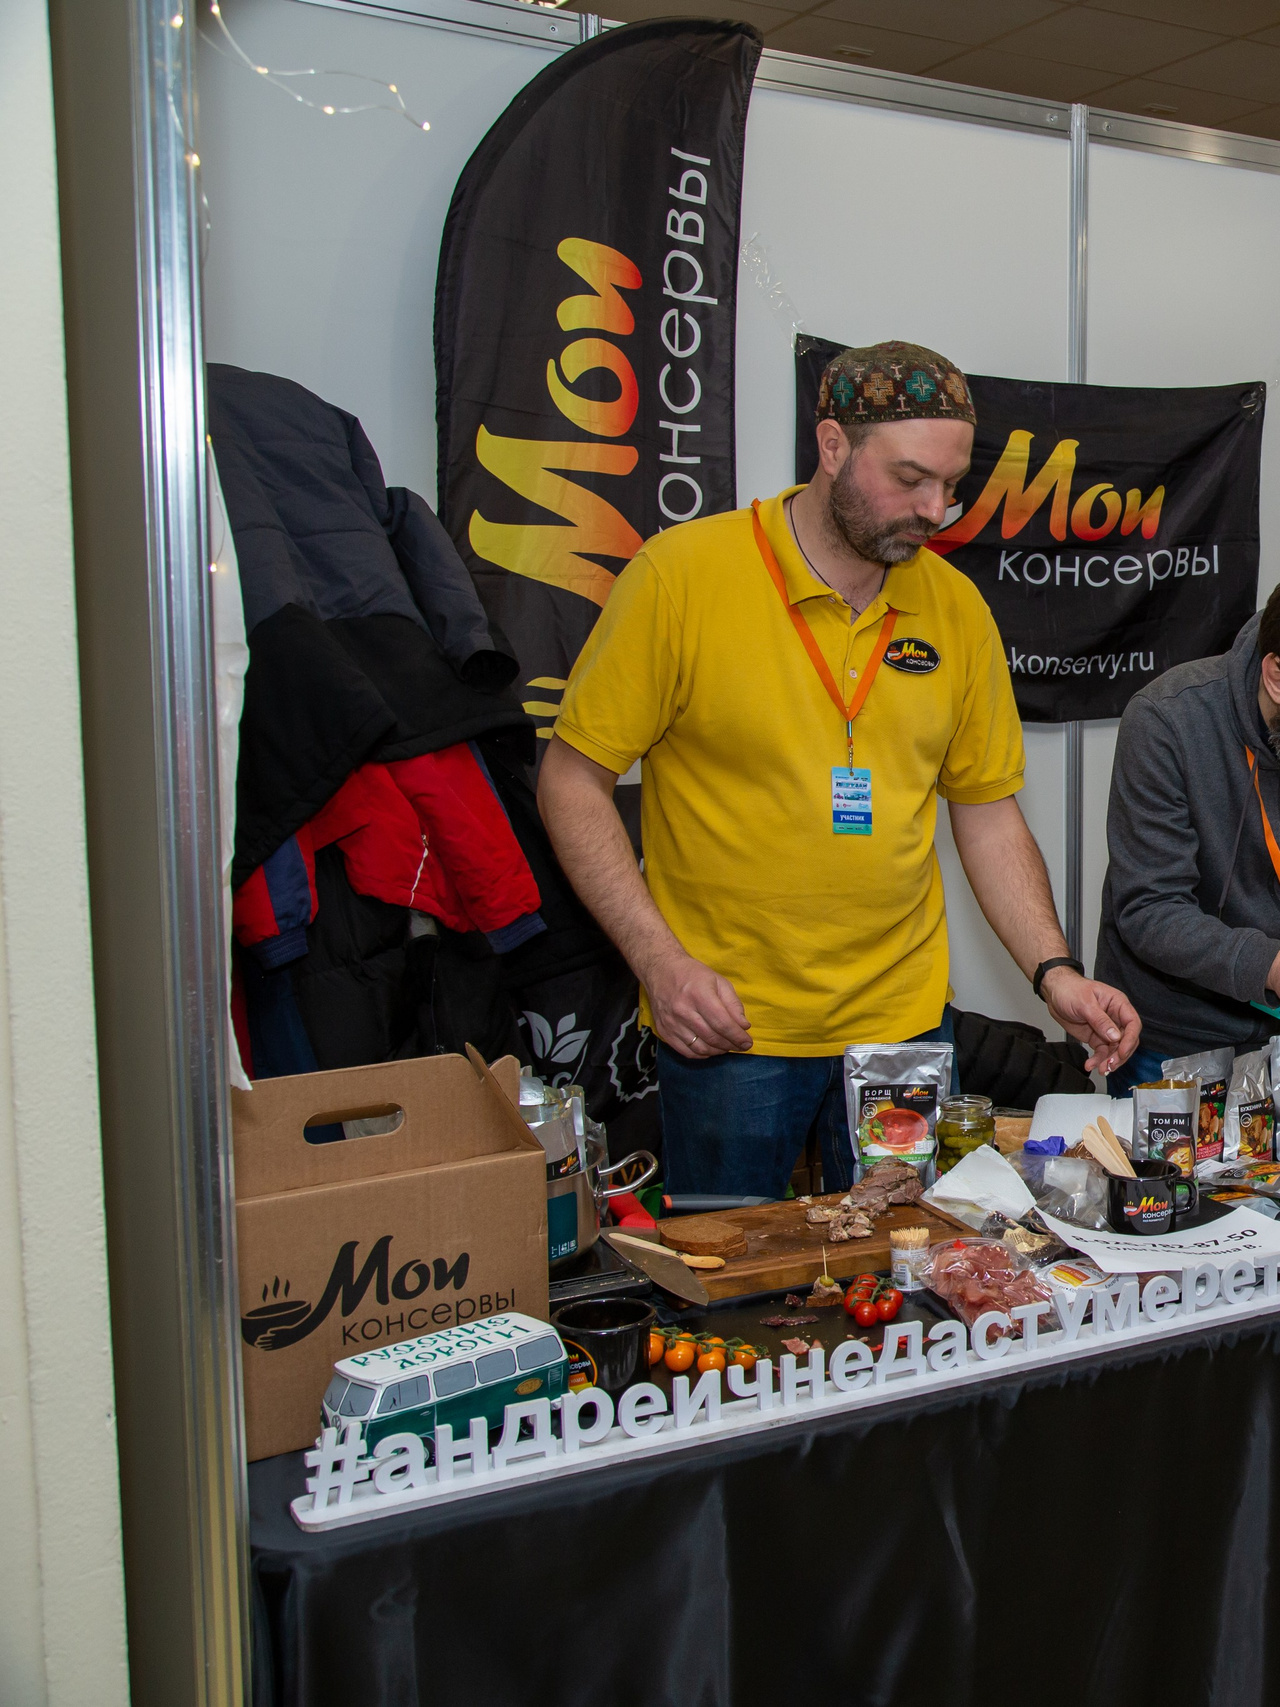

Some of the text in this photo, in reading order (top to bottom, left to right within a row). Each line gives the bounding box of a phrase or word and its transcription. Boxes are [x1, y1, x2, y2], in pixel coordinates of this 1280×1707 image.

[658, 147, 717, 533] онсервы
[469, 237, 643, 610] Мои
[945, 429, 1166, 548] Мои
[998, 544, 1220, 590] консервы
[1007, 646, 1155, 680] -konservy.ru
[864, 1089, 892, 1097] БОРЩ
[1137, 1196, 1168, 1213] Мои
[310, 1235, 470, 1320] Мои
[342, 1288, 516, 1346] консервы
[393, 1325, 531, 1370] ДОРОГИ
